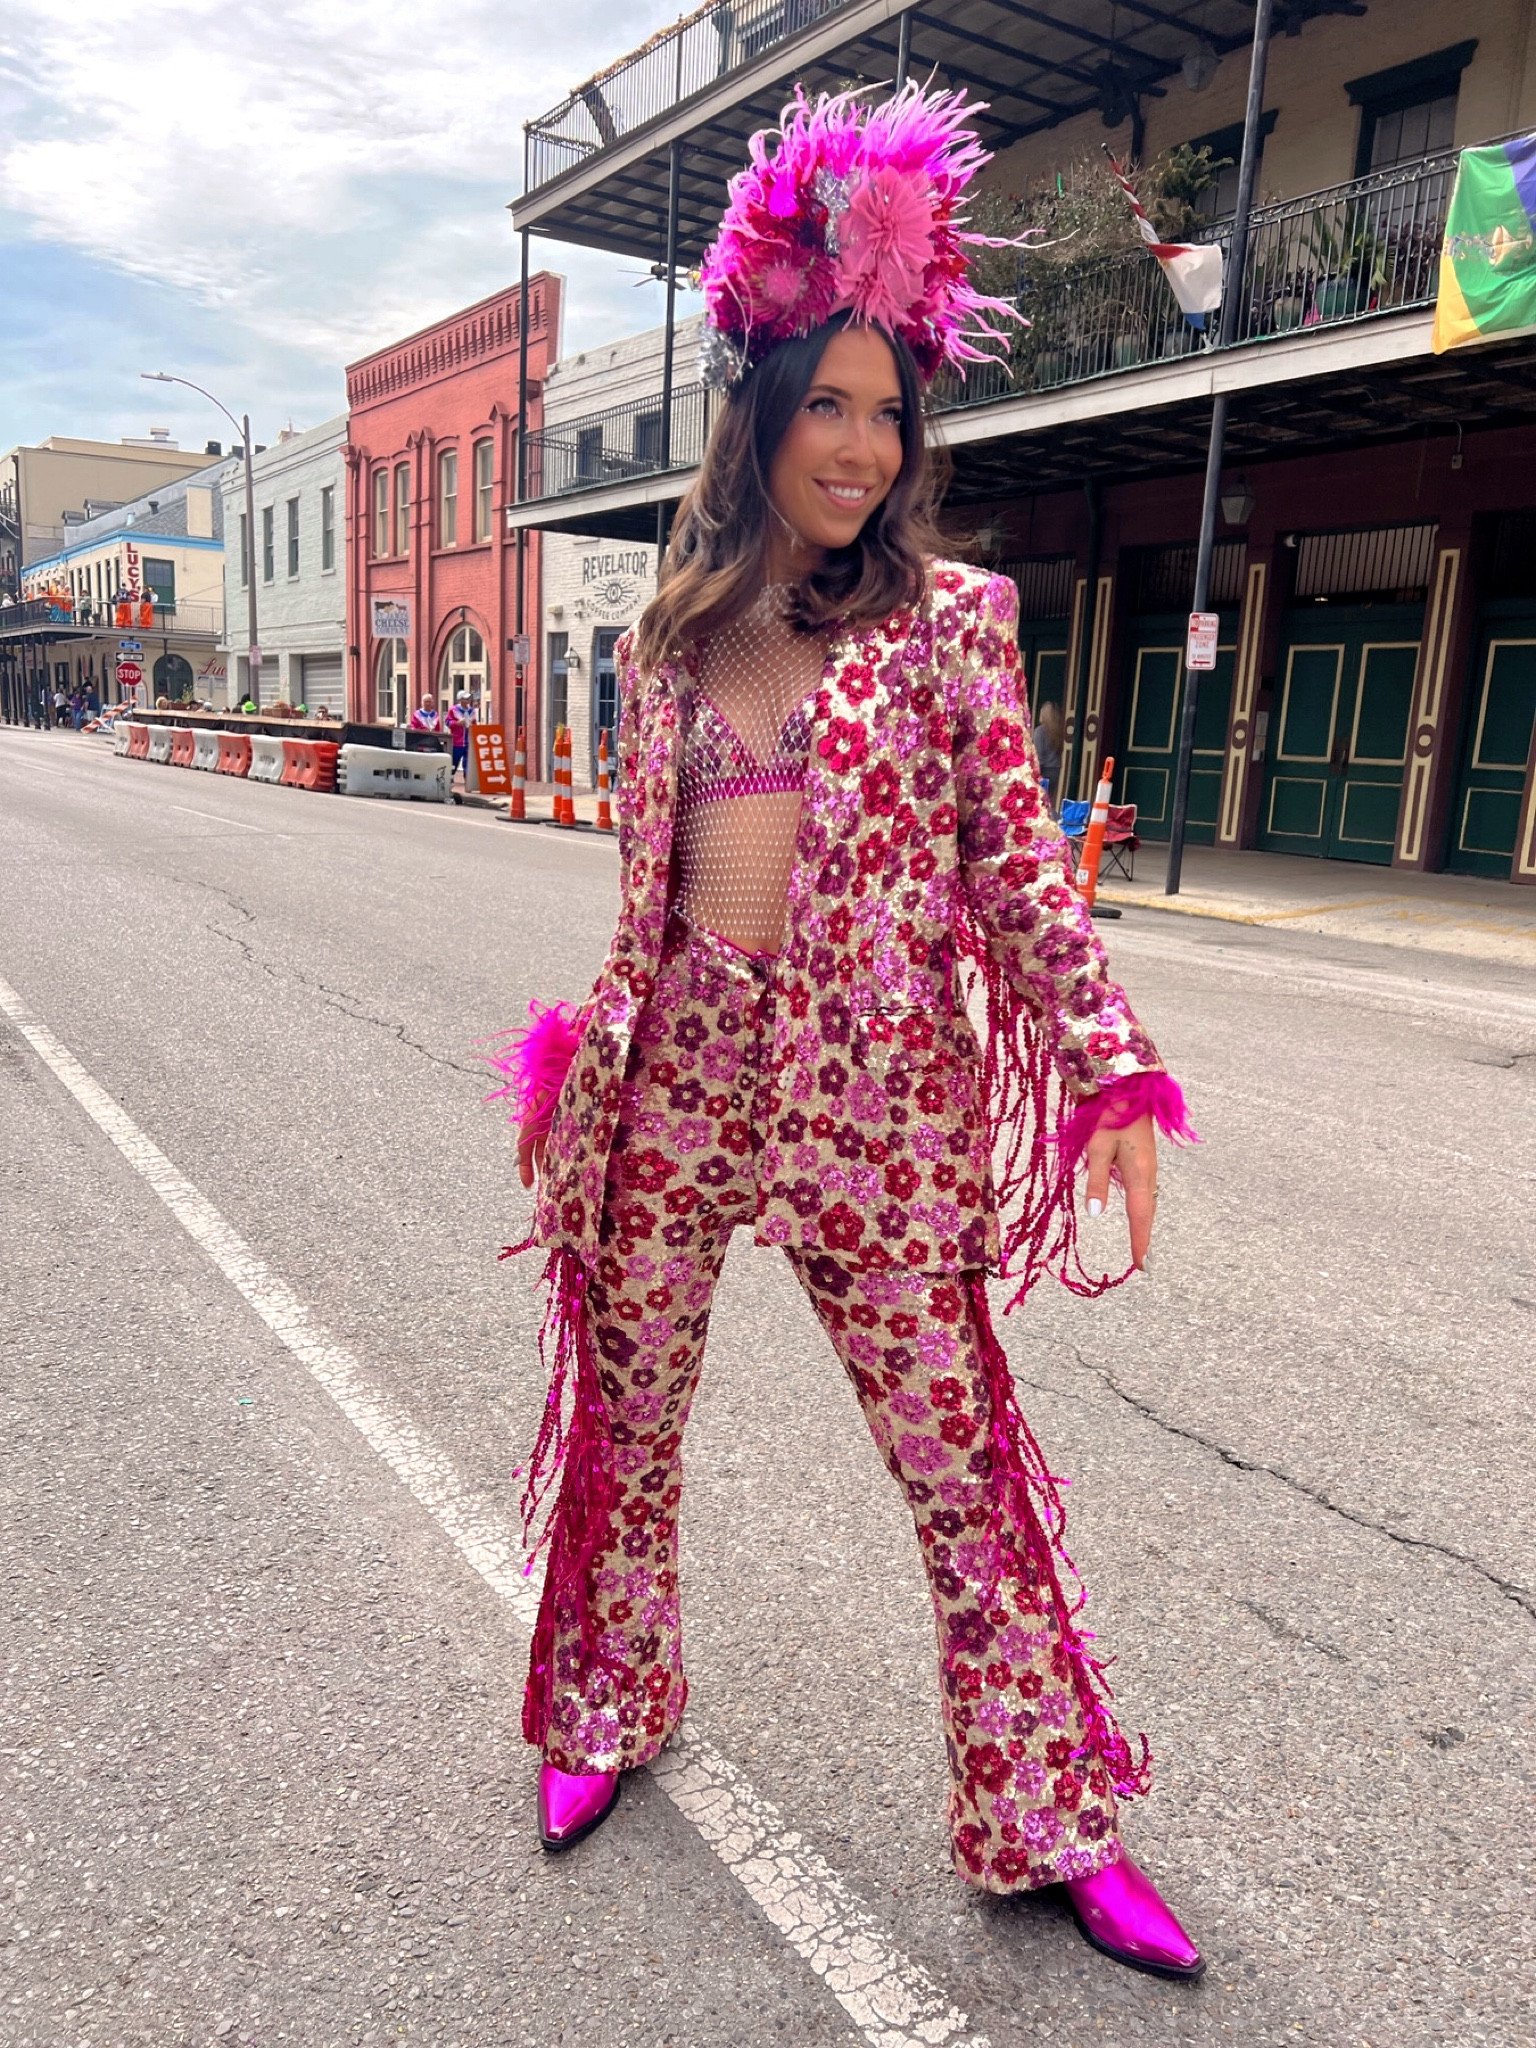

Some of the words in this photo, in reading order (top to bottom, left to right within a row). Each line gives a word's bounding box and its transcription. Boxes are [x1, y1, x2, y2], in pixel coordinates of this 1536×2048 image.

[583, 551, 647, 586] REVELATOR
[375, 619, 409, 628] CHEESE
[118, 669, 141, 679] STOP
